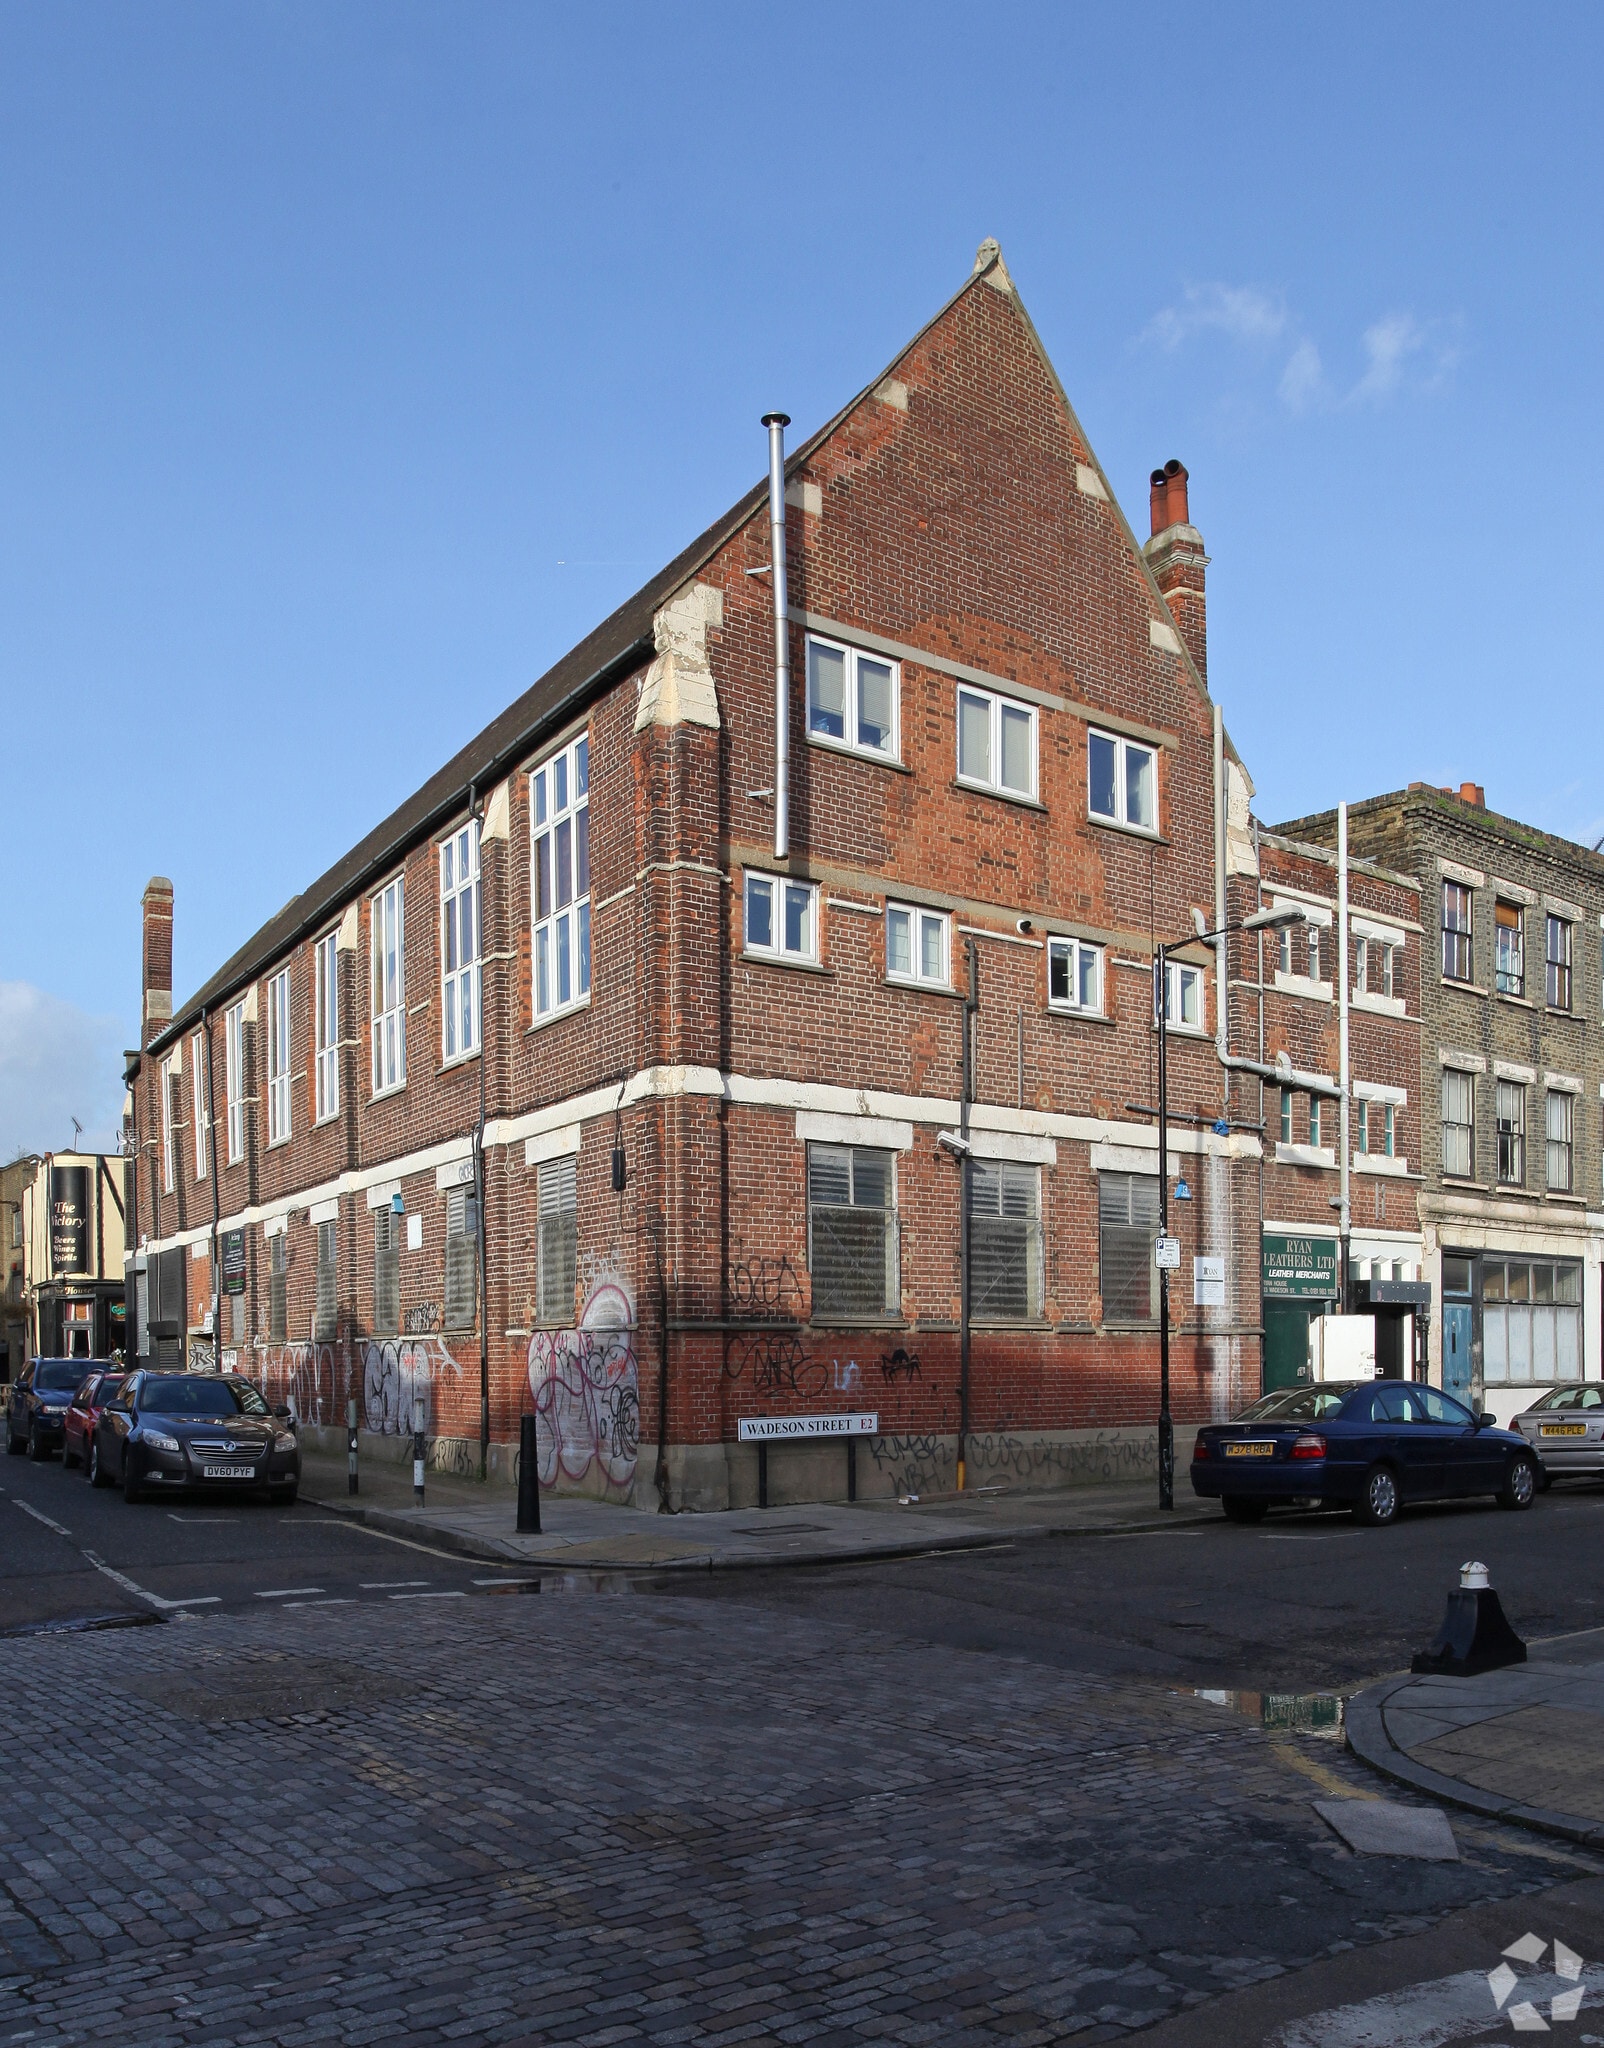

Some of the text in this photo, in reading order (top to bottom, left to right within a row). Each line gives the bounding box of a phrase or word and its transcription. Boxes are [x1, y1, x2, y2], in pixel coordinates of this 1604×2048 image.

[54, 1202, 76, 1214] The
[1286, 1239, 1313, 1254] RYAN
[1263, 1253, 1335, 1269] LEATHERS LTD
[1268, 1269, 1331, 1280] LEATHER MERCHANTS
[64, 1286, 92, 1295] House
[746, 1418, 873, 1435] WADESON STREET E2
[207, 1467, 251, 1476] DV60 PYF
